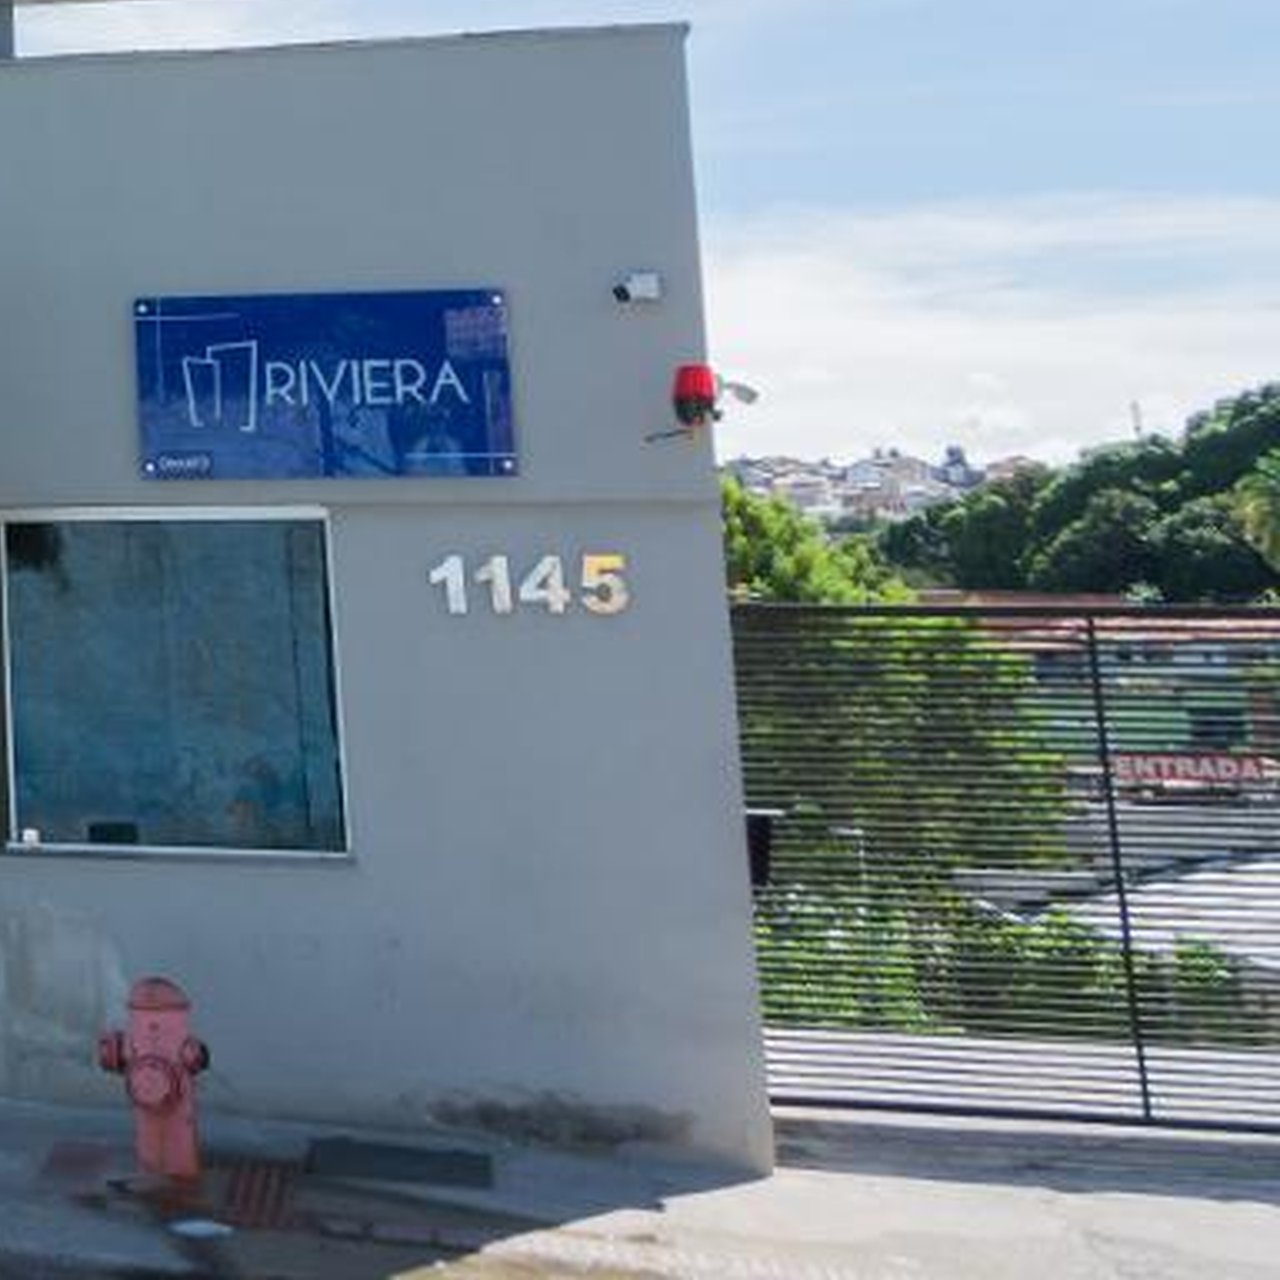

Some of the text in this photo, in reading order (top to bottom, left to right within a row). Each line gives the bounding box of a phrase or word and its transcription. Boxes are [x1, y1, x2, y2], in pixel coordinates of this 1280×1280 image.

[265, 359, 468, 405] RIVIERA
[428, 553, 630, 616] 1145
[1117, 755, 1260, 779] ENTRADA
